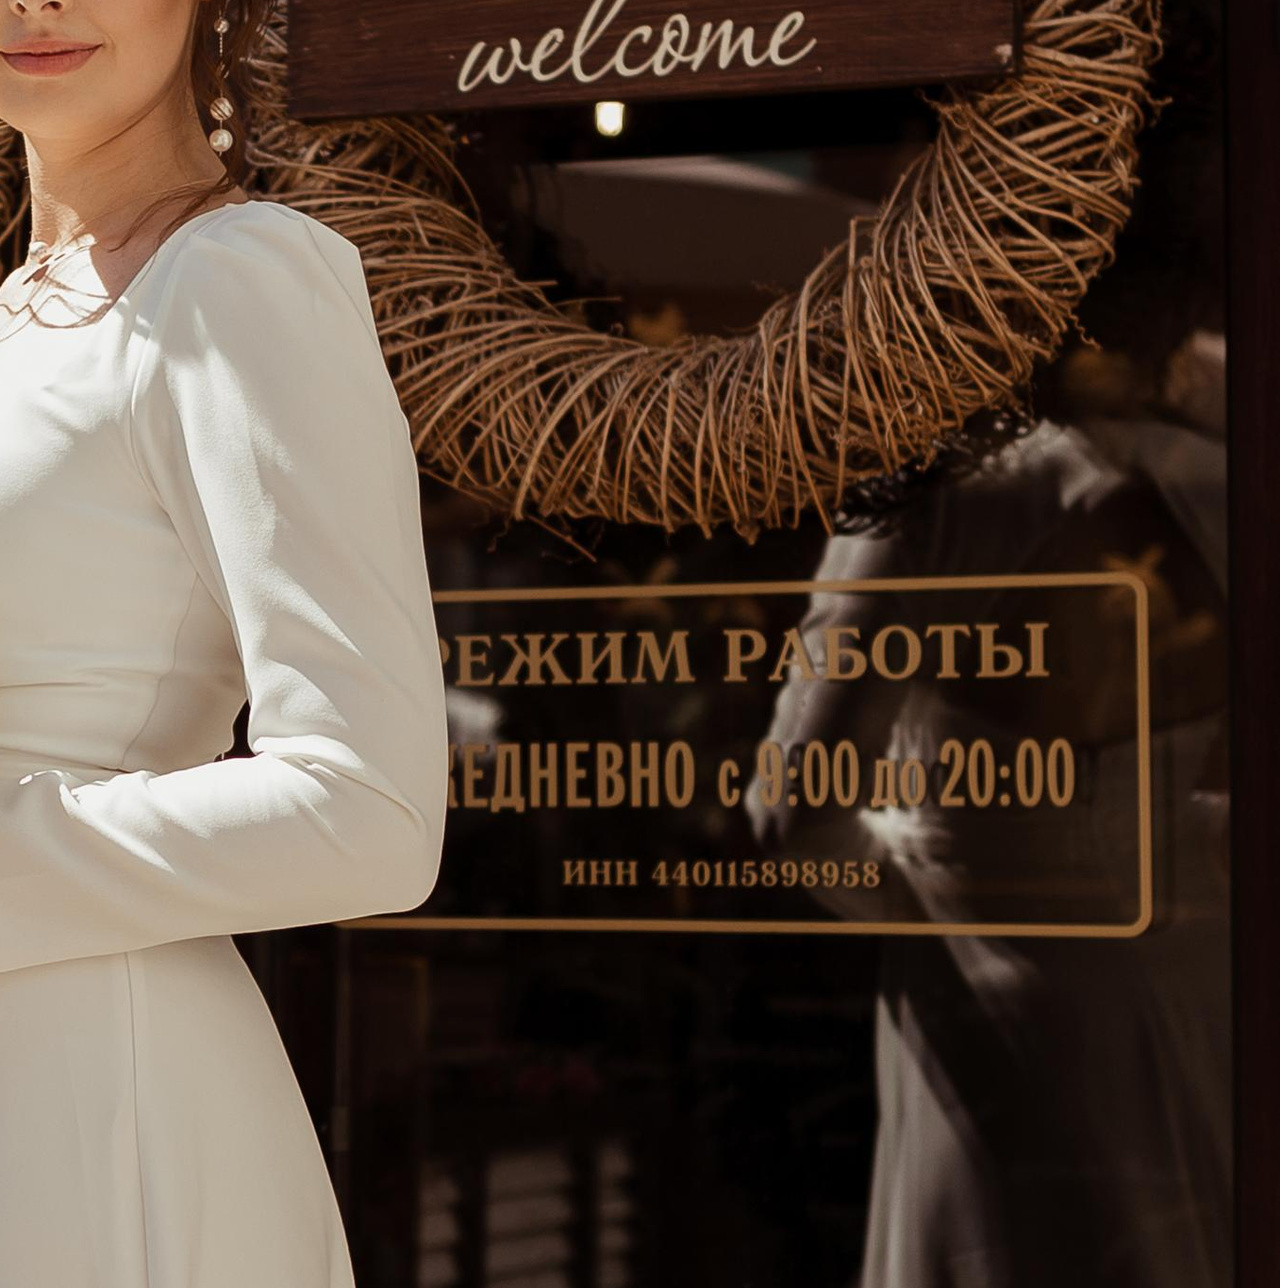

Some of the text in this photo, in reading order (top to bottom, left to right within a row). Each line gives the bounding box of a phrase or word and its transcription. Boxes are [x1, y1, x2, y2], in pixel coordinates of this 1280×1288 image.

[724, 623, 1050, 682] РАБОТЫ
[448, 741, 696, 813] ЕДНЕВНО
[758, 740, 860, 808] 9:00
[871, 759, 927, 811] до
[939, 738, 1076, 808] 20:00
[562, 861, 882, 888] ИНН 440115898958
